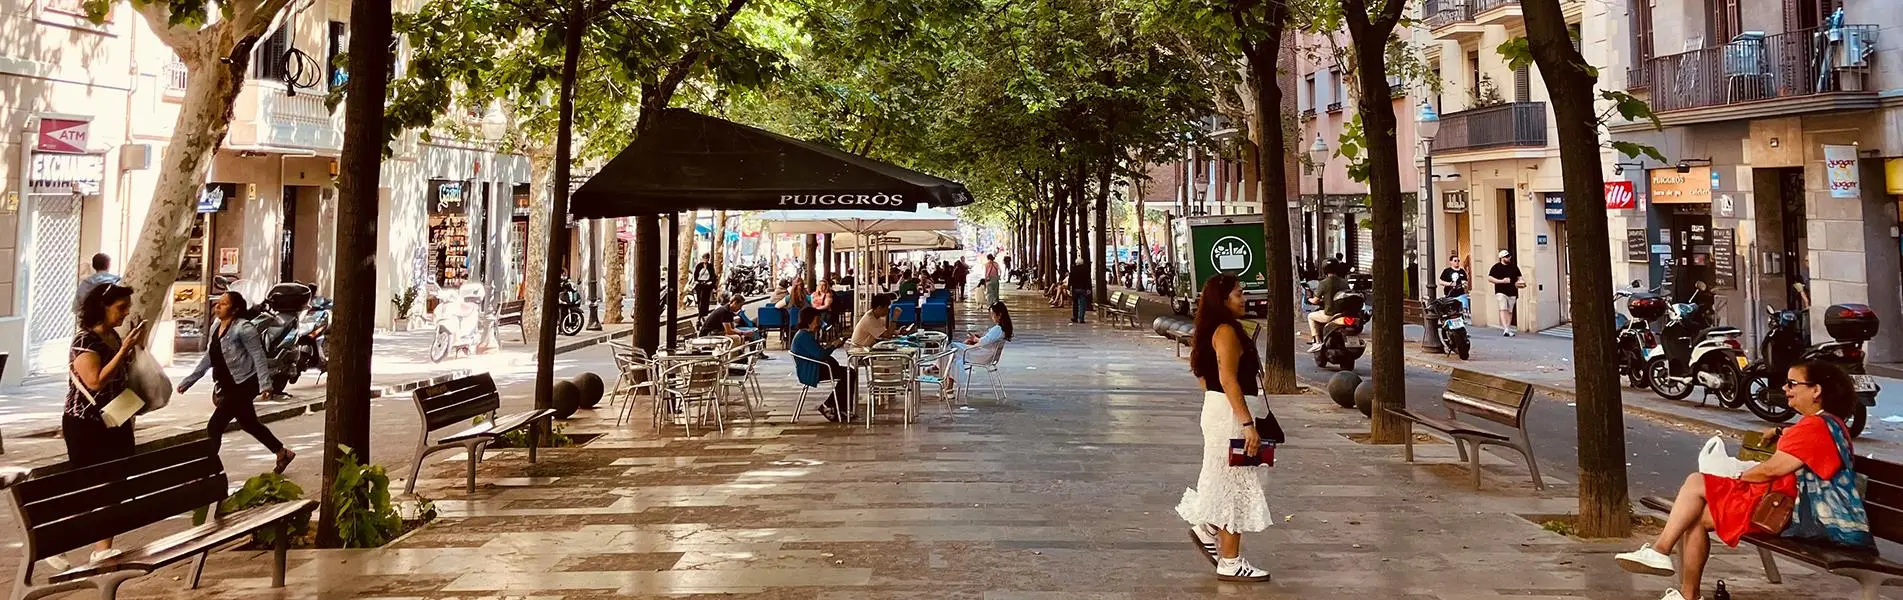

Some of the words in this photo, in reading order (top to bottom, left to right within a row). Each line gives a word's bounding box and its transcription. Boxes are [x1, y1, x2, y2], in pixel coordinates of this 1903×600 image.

[59, 131, 85, 141] ATM
[778, 192, 903, 206] PUIGGRÒS
[1606, 185, 1632, 207] illy
